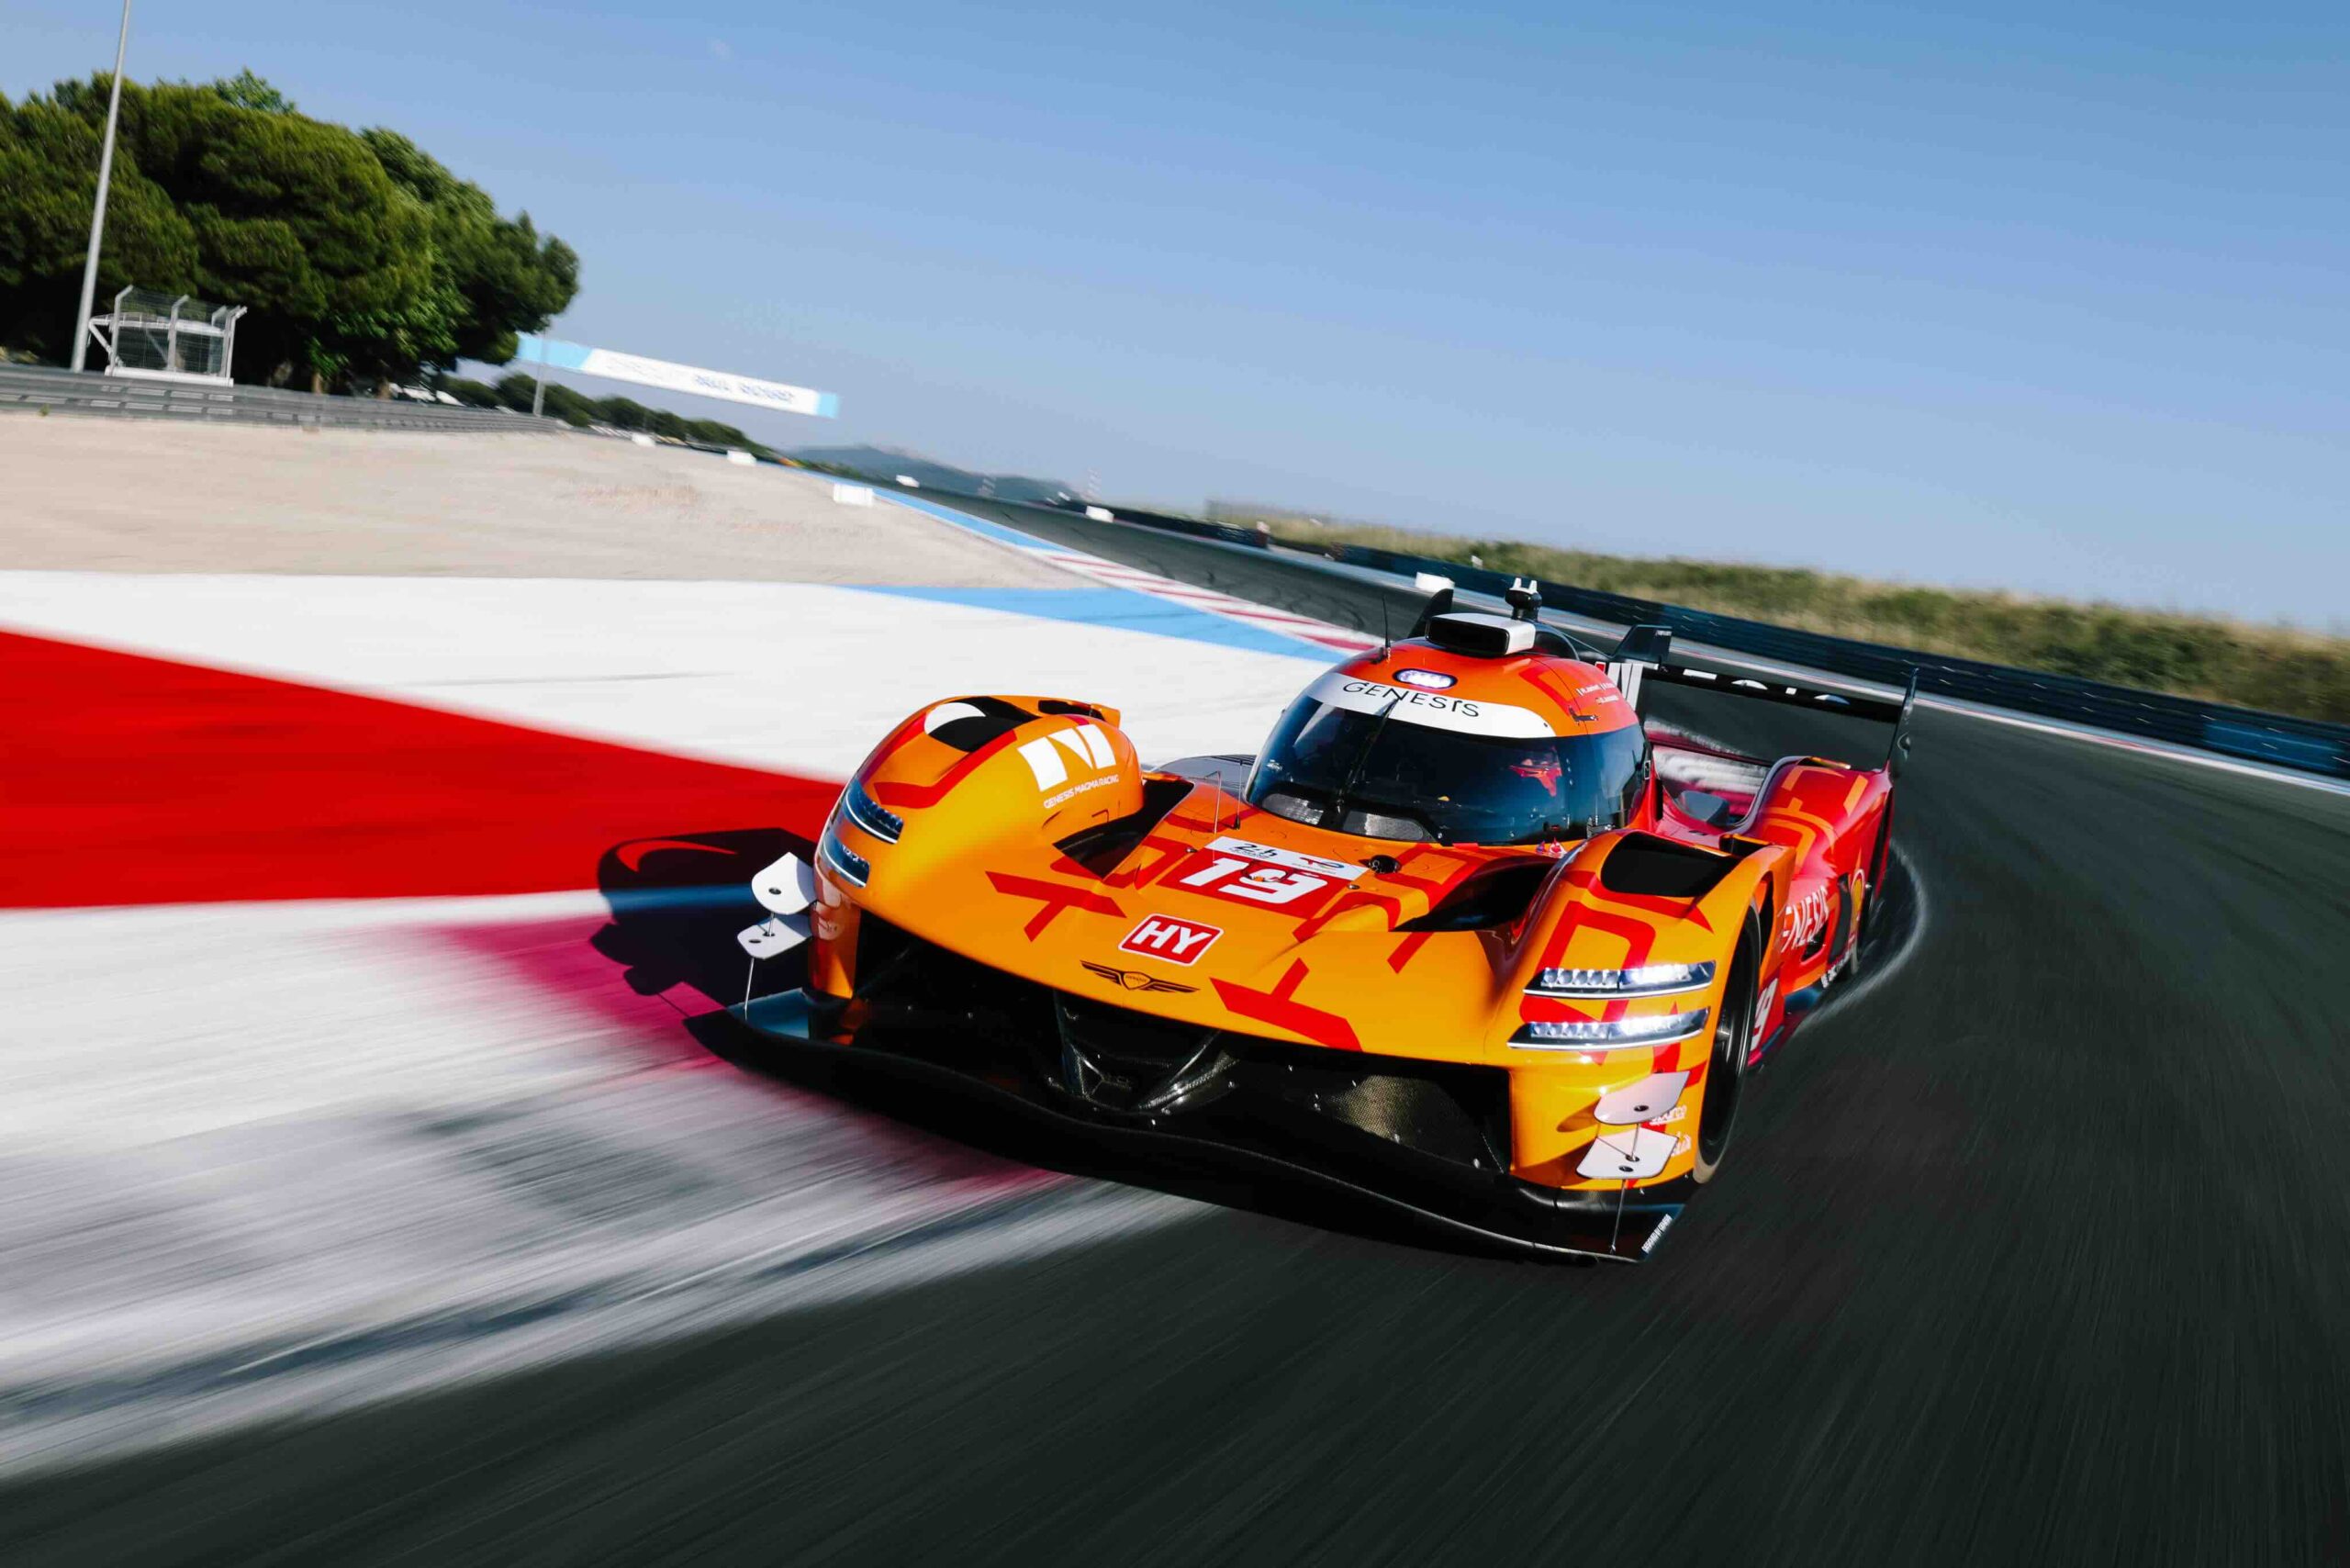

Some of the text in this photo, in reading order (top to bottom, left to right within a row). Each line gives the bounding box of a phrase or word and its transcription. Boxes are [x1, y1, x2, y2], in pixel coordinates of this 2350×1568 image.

[1343, 681, 1480, 718] GENESIS
[1180, 857, 1328, 903] 19
[1132, 921, 1212, 955] HY
